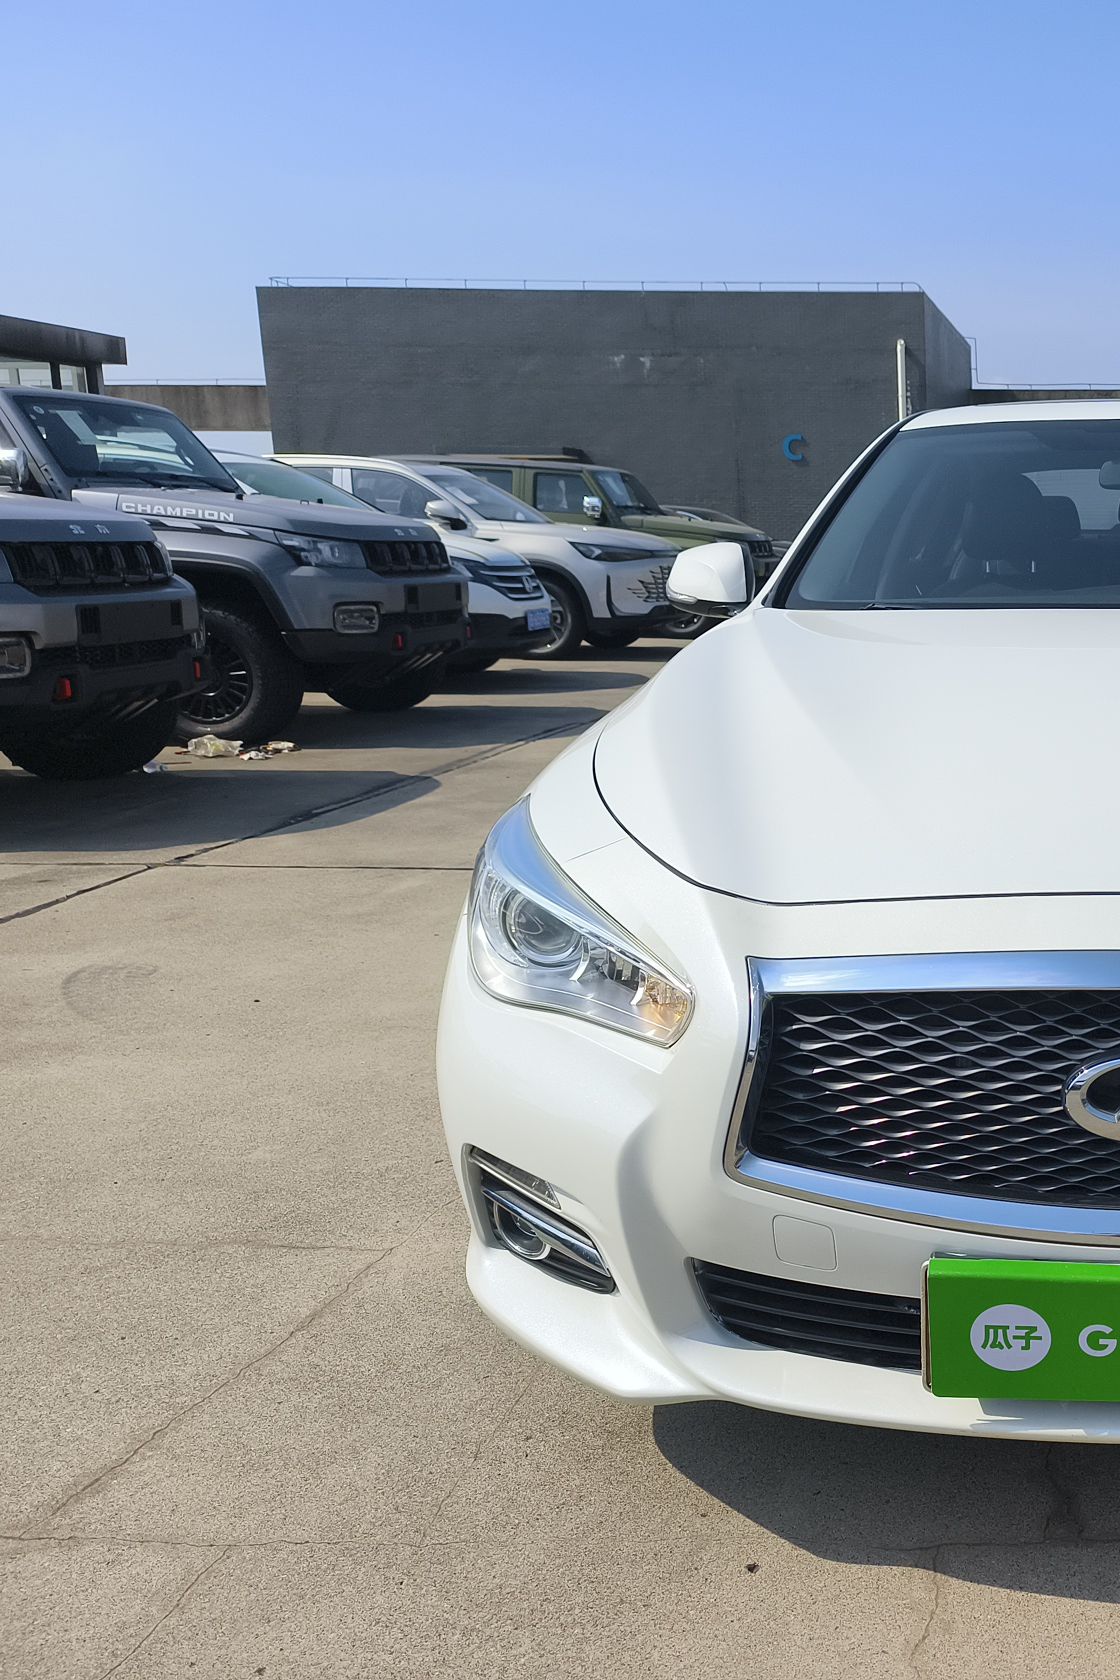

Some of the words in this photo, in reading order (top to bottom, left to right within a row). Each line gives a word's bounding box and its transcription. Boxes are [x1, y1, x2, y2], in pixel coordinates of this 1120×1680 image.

[783, 433, 803, 462] C
[121, 502, 234, 522] CHAMPION
[980, 1323, 1043, 1351] 瓜子
